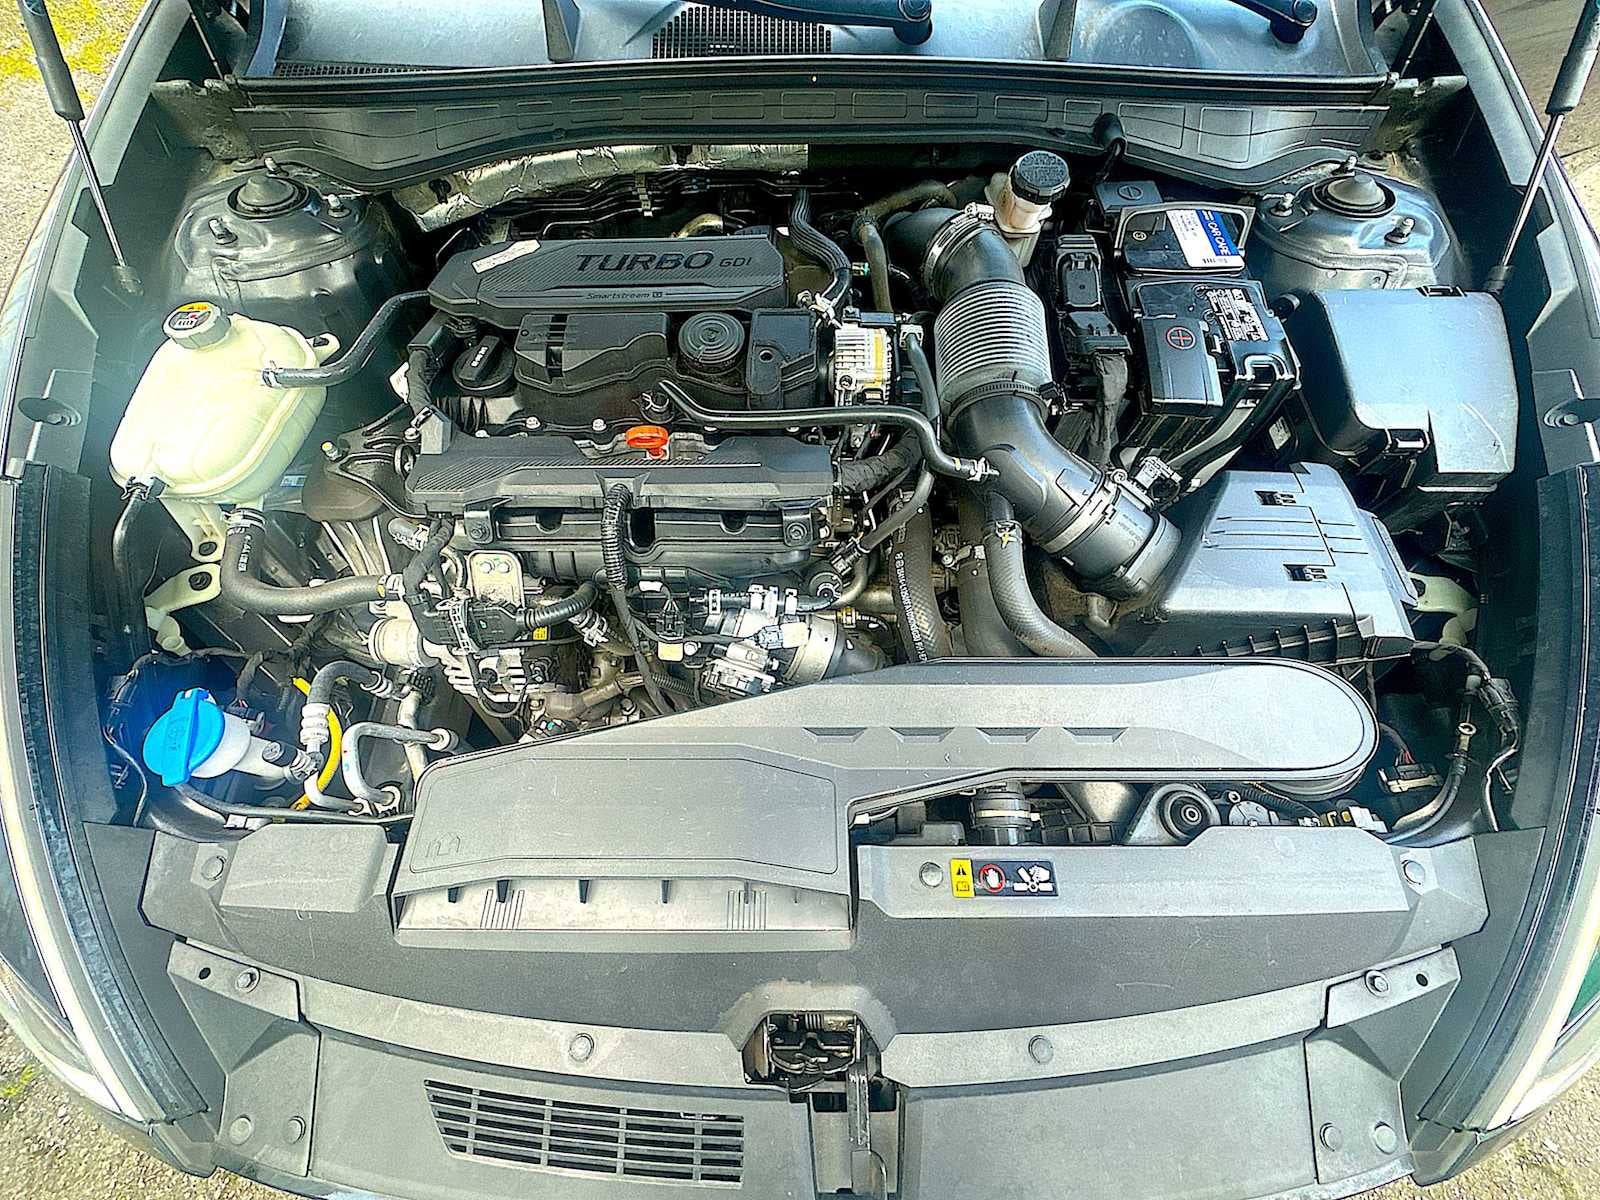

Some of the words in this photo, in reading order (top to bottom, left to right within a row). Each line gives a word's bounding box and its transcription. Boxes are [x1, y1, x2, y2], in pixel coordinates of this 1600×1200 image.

[576, 251, 714, 271] TURBO
[719, 257, 752, 267] GDI
[586, 292, 650, 300] Smartstream
